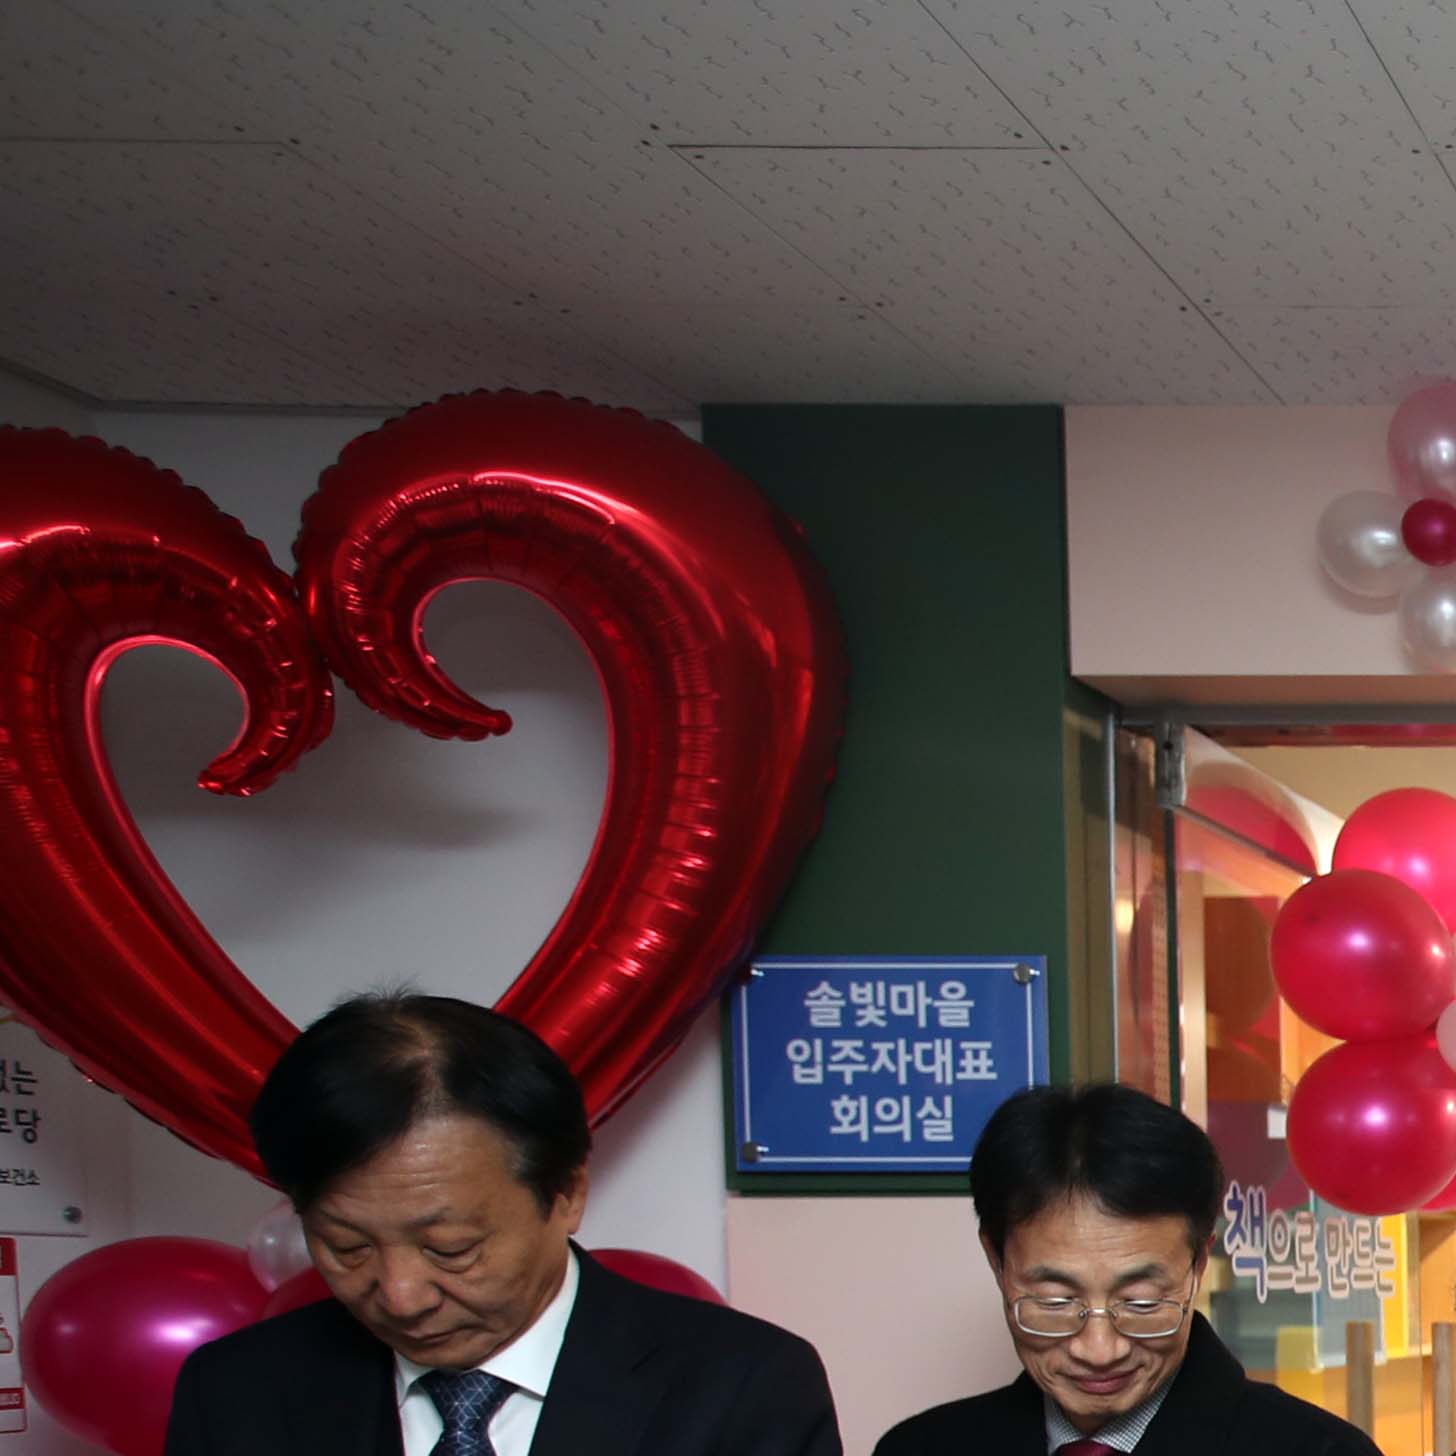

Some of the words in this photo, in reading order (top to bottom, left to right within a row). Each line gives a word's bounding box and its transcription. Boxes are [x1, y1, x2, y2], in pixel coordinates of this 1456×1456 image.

[804, 981, 975, 1028] 솔빛마을
[786, 1039, 998, 1085] 입주자대표
[829, 1095, 954, 1142] 회의실
[1225, 1181, 1320, 1301] 책으로
[1325, 1217, 1395, 1297] 만드는
